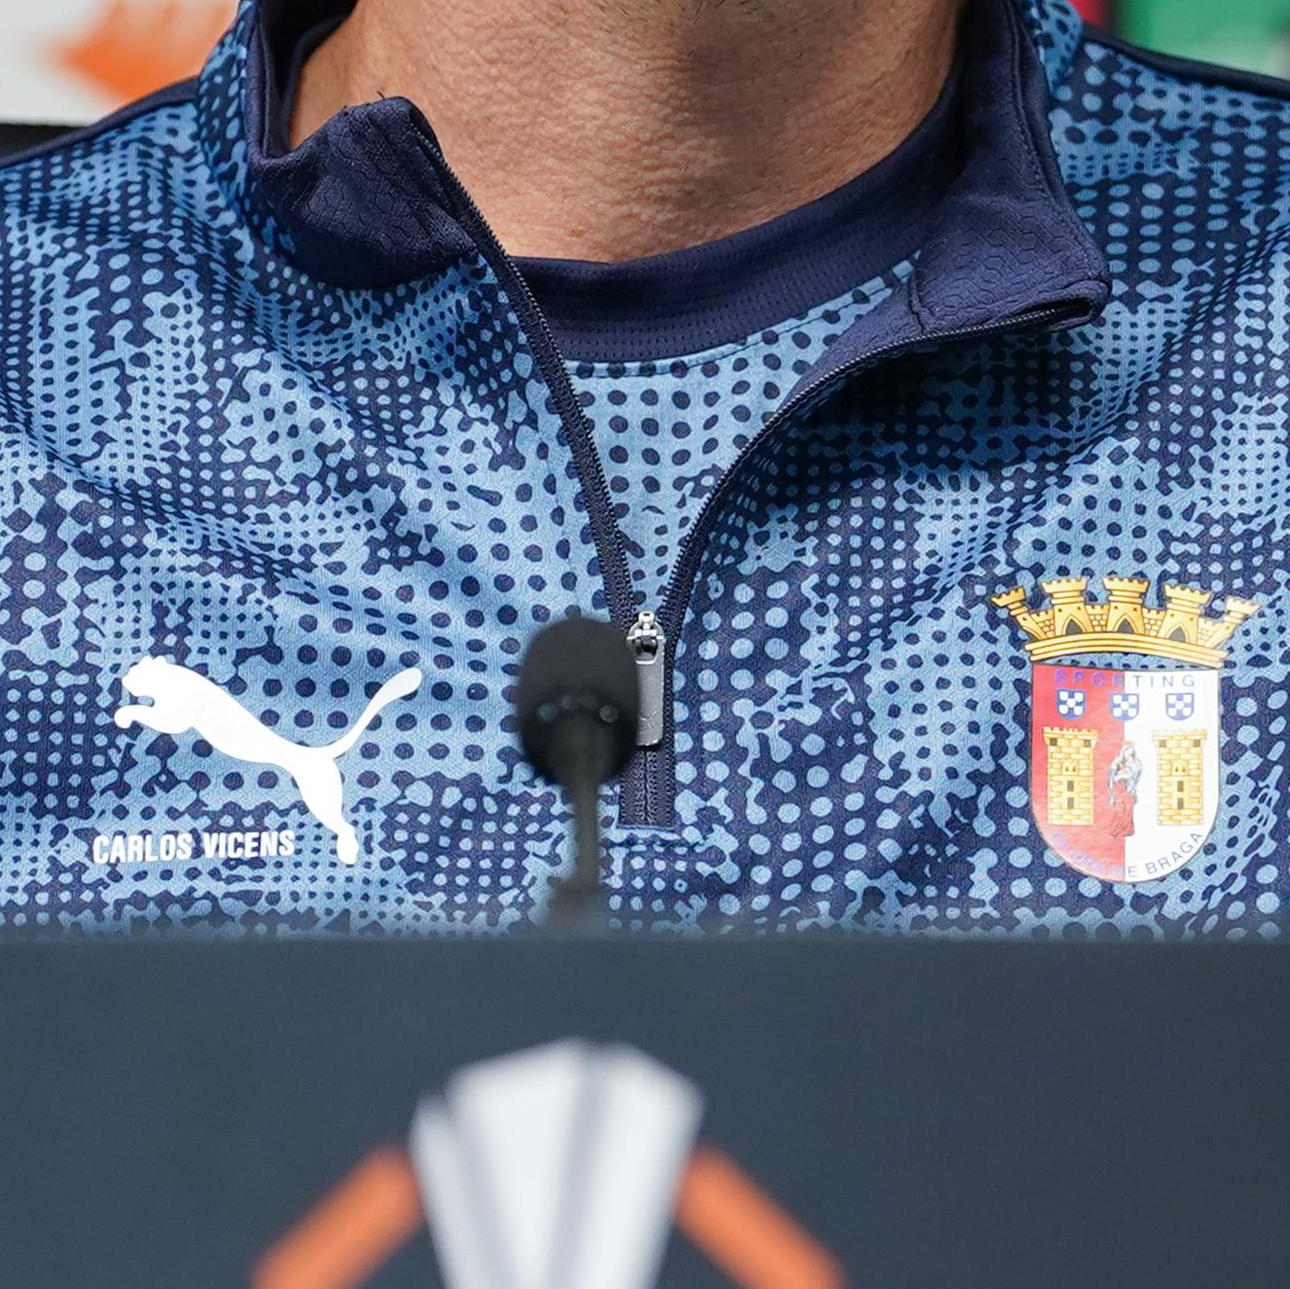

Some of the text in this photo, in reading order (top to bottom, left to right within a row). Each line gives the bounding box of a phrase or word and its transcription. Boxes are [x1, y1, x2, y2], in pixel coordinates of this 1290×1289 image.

[92, 828, 295, 864] CARLOS VICENS
[1146, 831, 1204, 875] BRAGA
